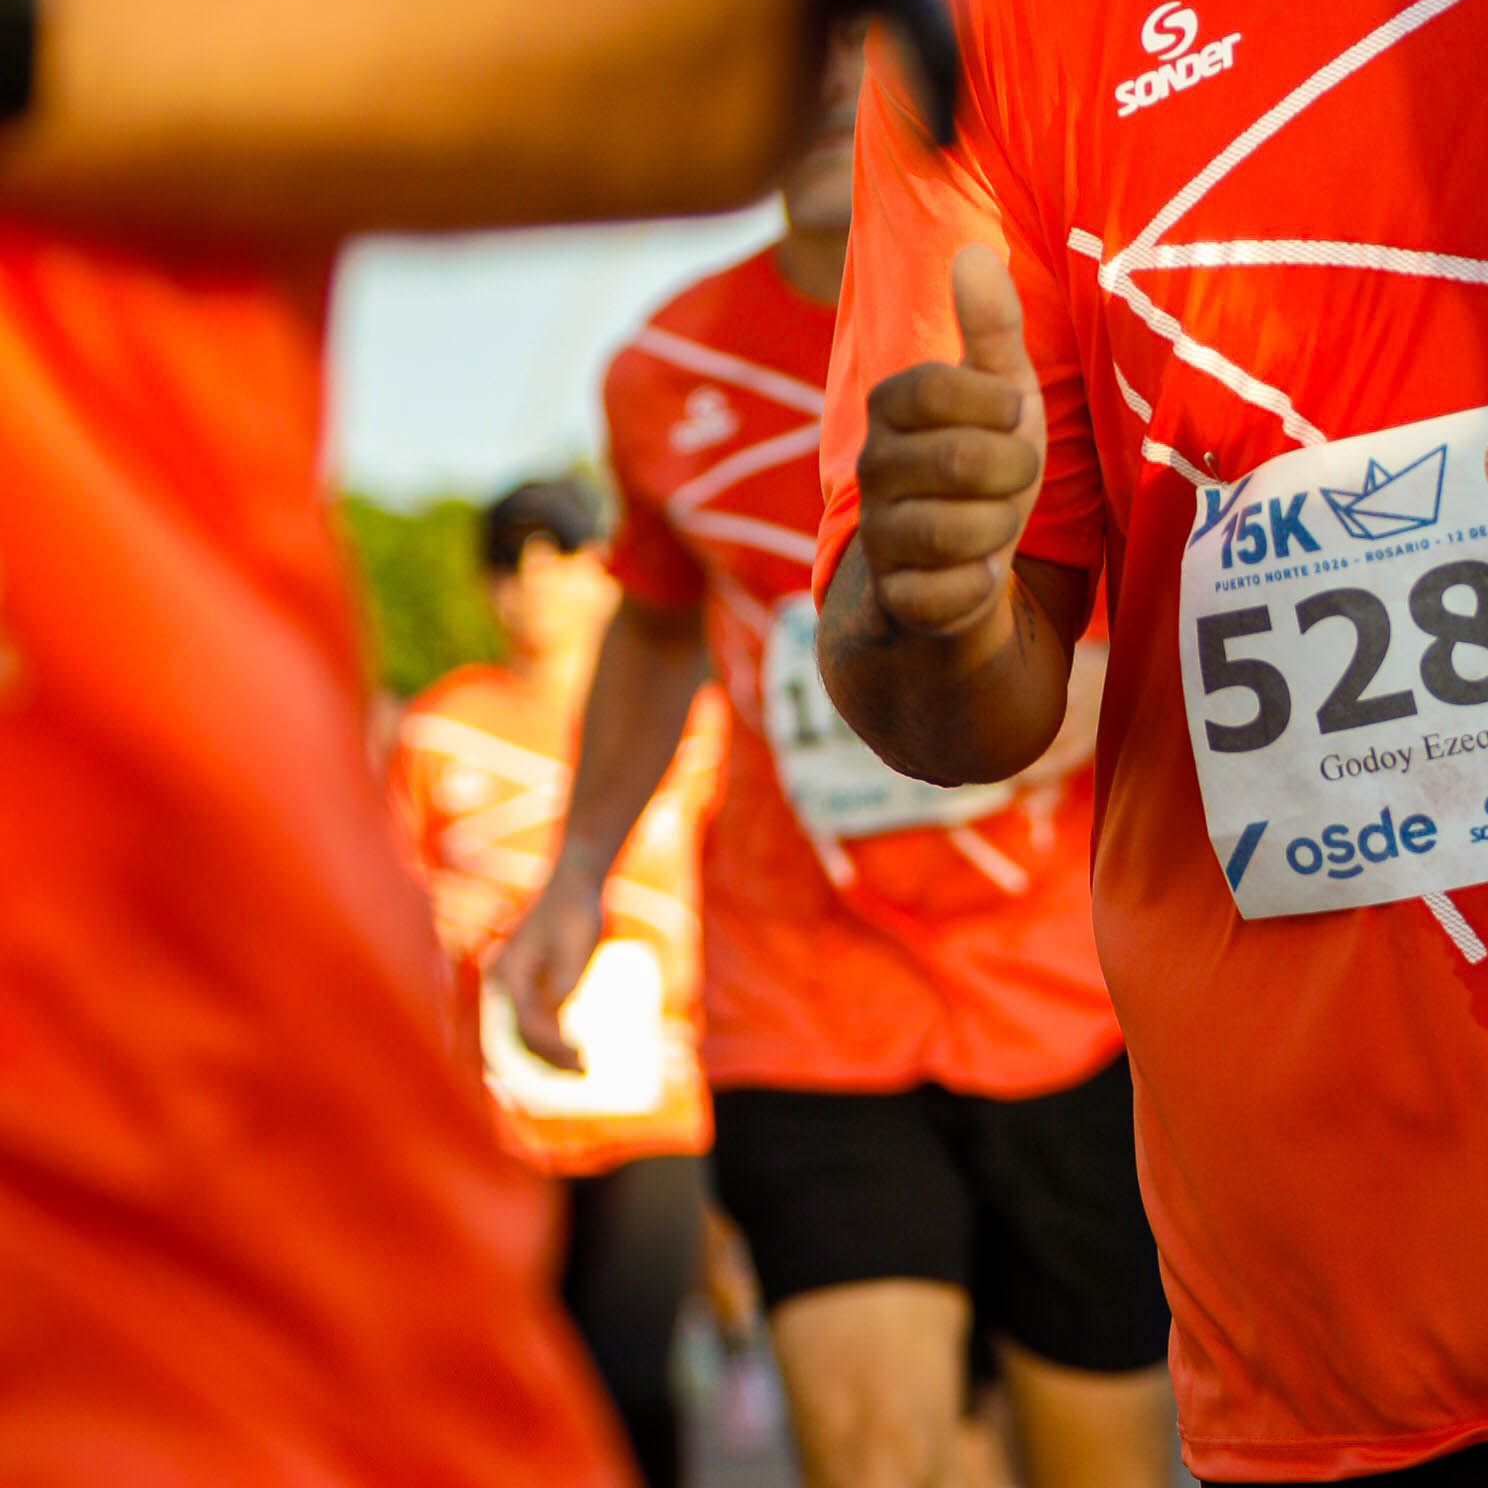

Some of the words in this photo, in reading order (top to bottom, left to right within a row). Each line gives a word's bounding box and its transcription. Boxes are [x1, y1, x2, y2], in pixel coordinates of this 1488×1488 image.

[1214, 574, 1261, 593] PUERTO
[1265, 565, 1309, 583] NORTE
[1365, 538, 1430, 562] ROSARIO
[1448, 531, 1464, 543] 12
[1469, 523, 1488, 539] DE
[1221, 491, 1321, 570] 15K
[1320, 746, 1413, 782] Godoy
[1286, 805, 1438, 876] osde
